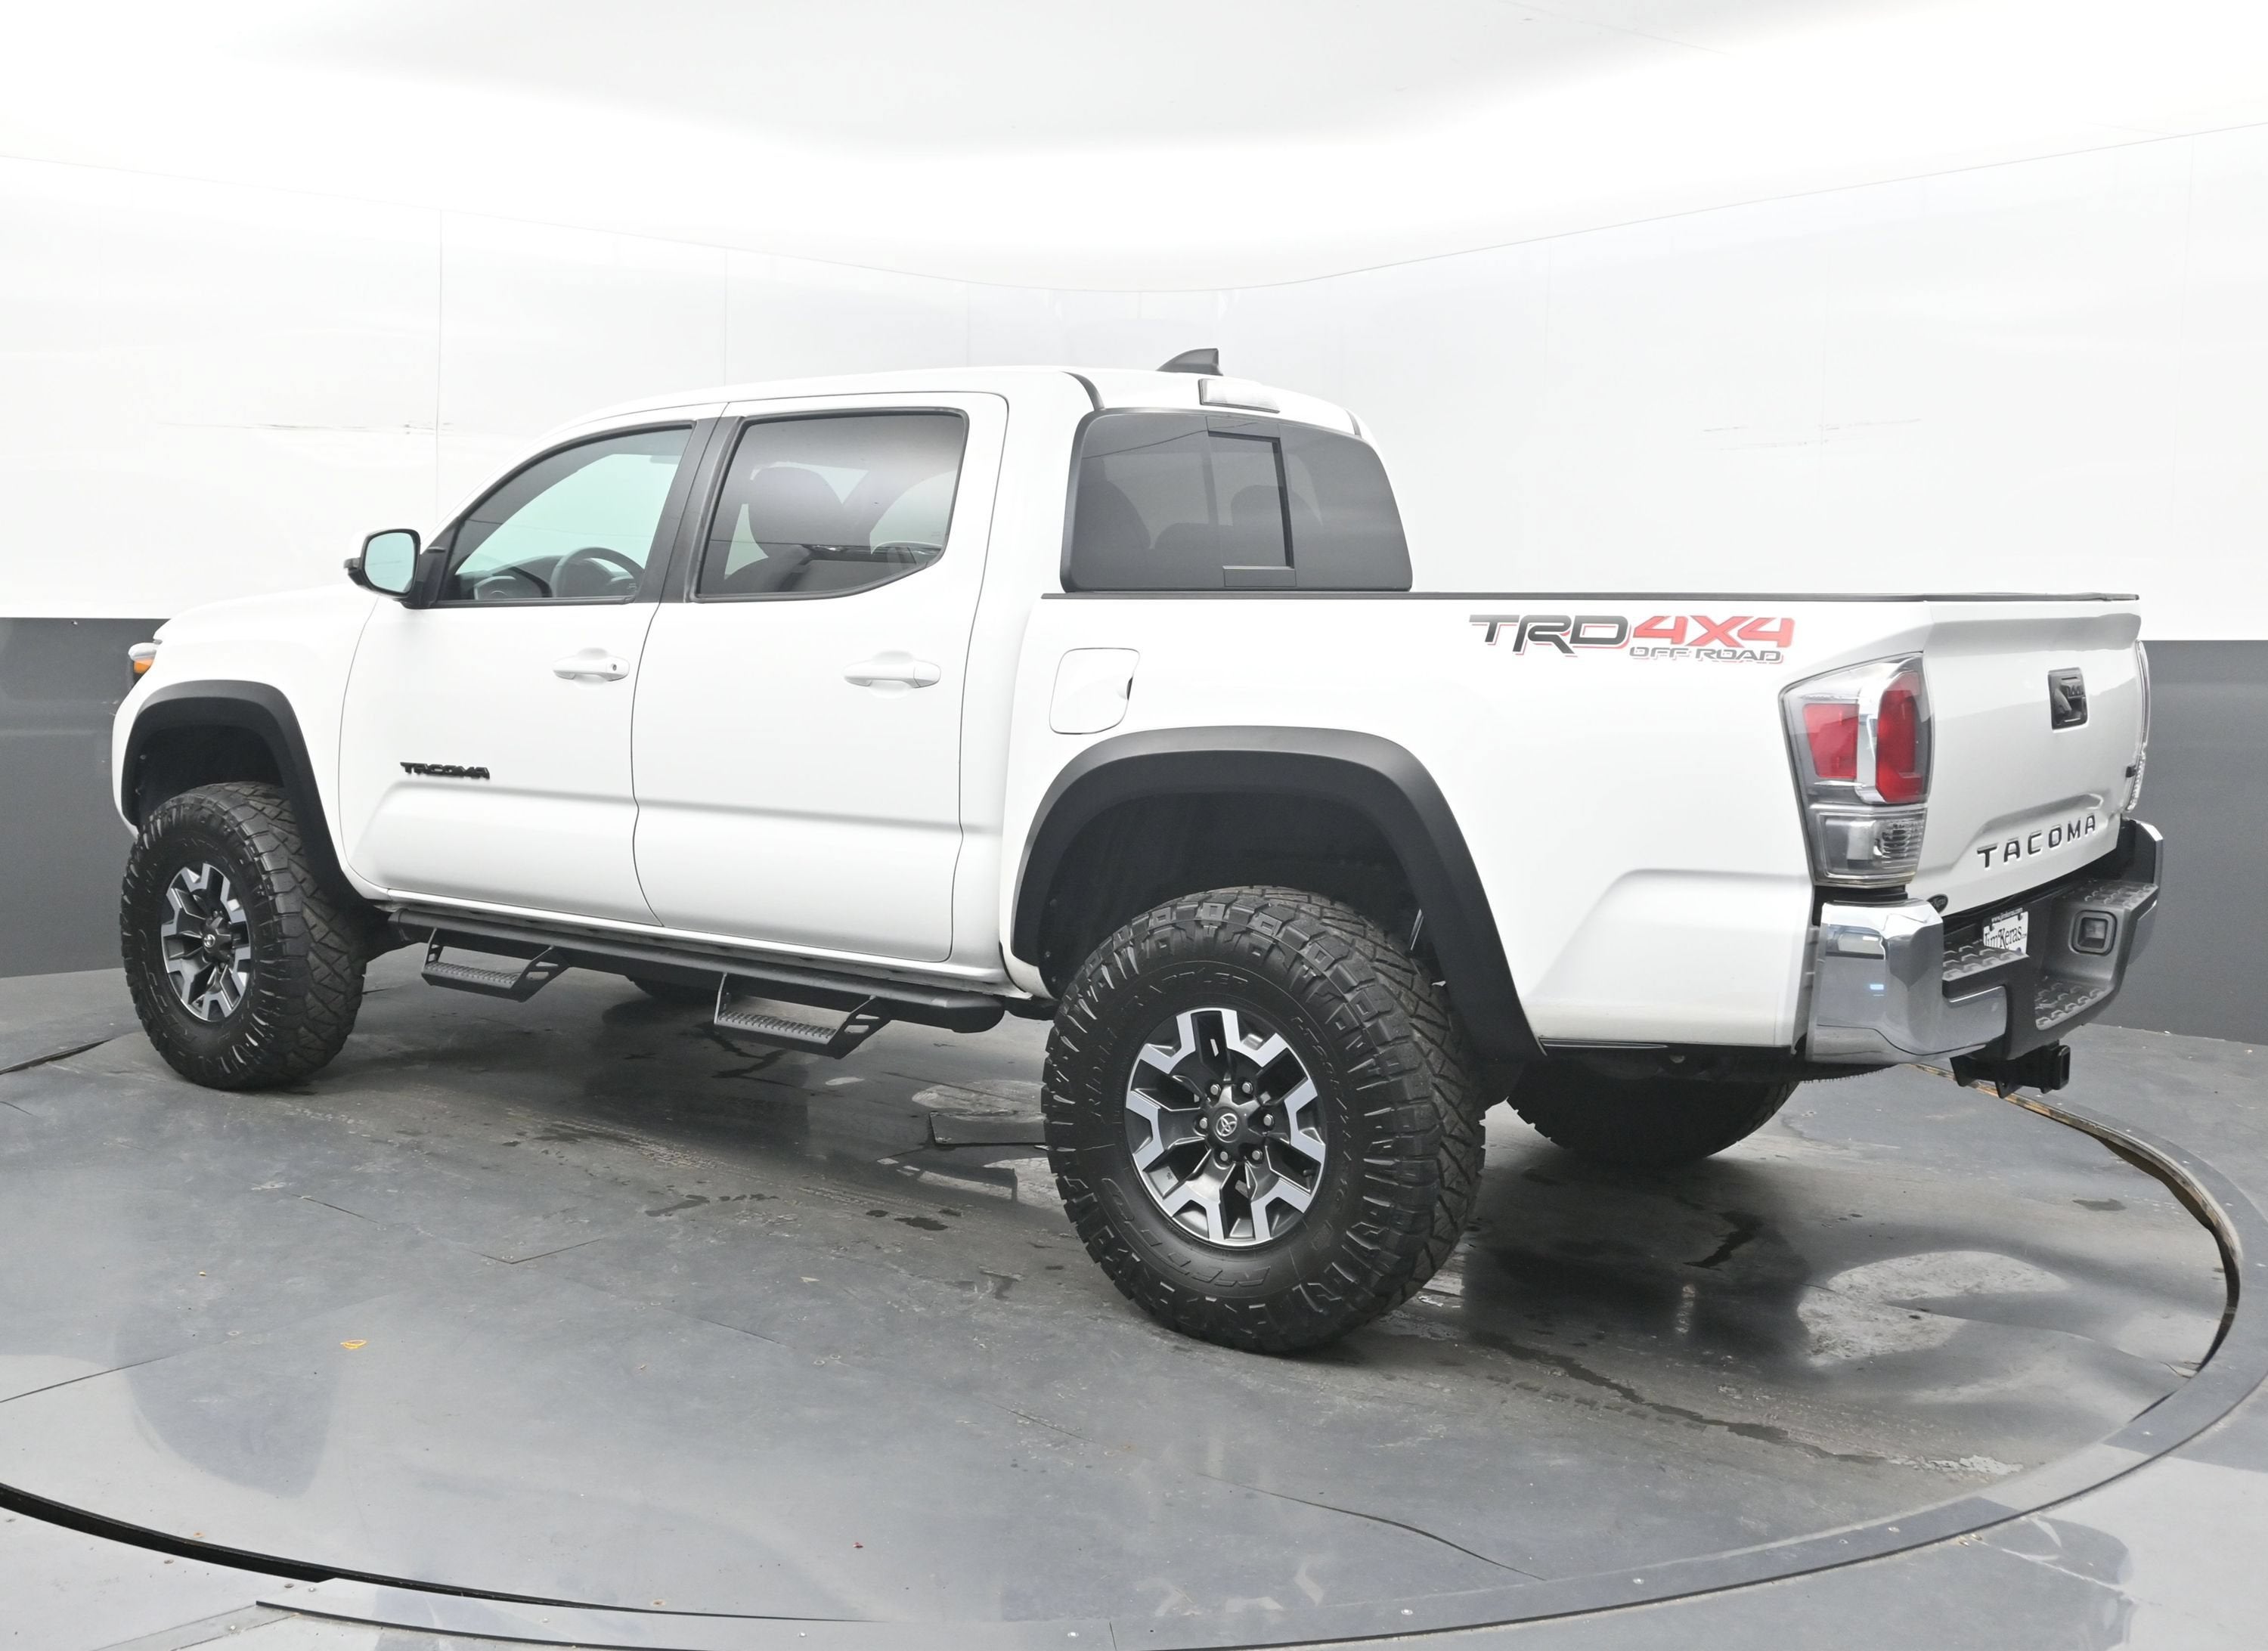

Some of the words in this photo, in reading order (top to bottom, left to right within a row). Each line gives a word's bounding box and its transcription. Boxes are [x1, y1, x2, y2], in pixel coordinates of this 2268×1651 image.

[1469, 615, 1631, 658] TRD
[1629, 646, 1690, 660] OFF
[1694, 648, 1784, 664] ROAD
[399, 761, 491, 780] TACOMA
[1976, 813, 2096, 869] TACOMA
